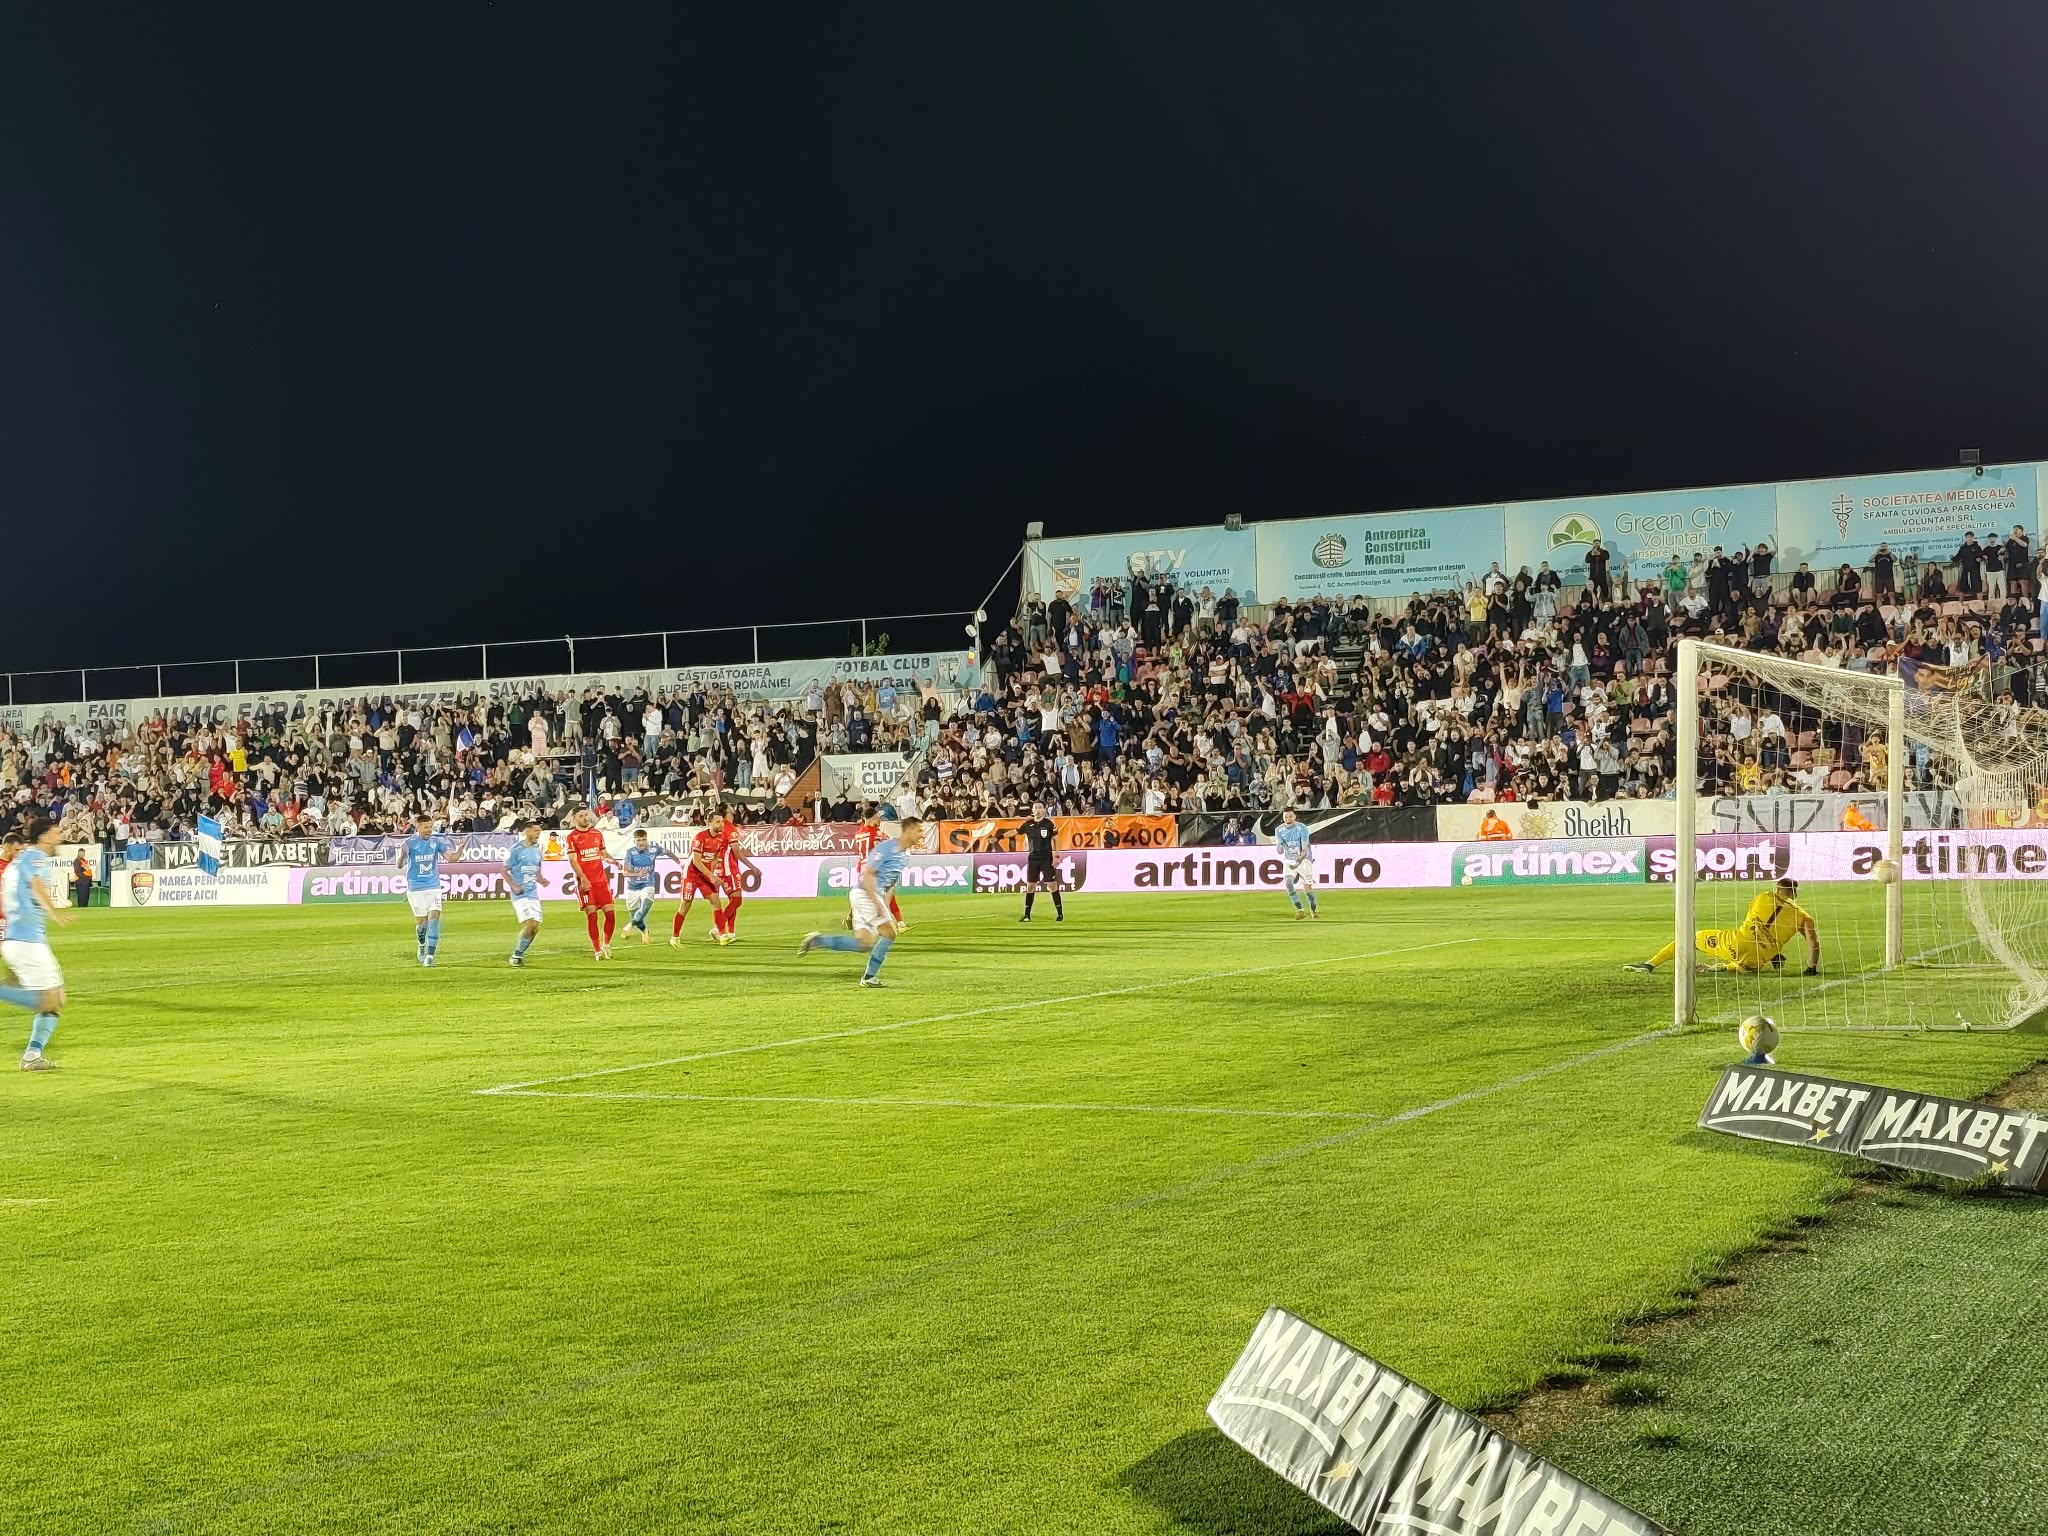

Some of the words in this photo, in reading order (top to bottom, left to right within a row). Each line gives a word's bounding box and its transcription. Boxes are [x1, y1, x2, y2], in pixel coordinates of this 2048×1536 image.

[1863, 492, 1943, 508] SOCIETATEA
[1946, 484, 2016, 502] MEDICALĂ
[1952, 501, 2016, 513] PARASCHEVA
[1615, 512, 1683, 535] Green
[1691, 506, 1734, 532] City
[1902, 515, 1955, 526] VOLUNTARI
[1957, 513, 1975, 522] SRL
[1364, 528, 1426, 541] Antrepriza
[1883, 525, 1934, 536] AMBULATORIU
[1946, 521, 1997, 531] SPECIALITATE
[1639, 532, 1708, 548] Voluntari
[1130, 548, 1187, 574] STV
[1364, 553, 1405, 566] Montaj
[1184, 568, 1230, 578] VOLUNTARI
[835, 658, 888, 673] FOTBAL
[893, 656, 930, 670] CLUB
[489, 681, 519, 699] SAY
[733, 675, 791, 690] ROMÂNIEI
[88, 703, 127, 718] FAIR
[861, 760, 906, 771] FOTBAL
[1564, 806, 1632, 837] Sheikh
[838, 838, 856, 851] TV
[246, 842, 319, 868] MAXBET
[1463, 843, 1640, 878] artimex
[1133, 852, 1381, 887] artime.ro
[159, 875, 193, 887] MAREA
[310, 870, 408, 896] artime
[158, 888, 192, 901] ÎNCEPE
[194, 889, 218, 900] AICI!
[1711, 1071, 1872, 1135] MAXBET
[1865, 1095, 2048, 1169] MAXBET
[1229, 1309, 1428, 1477] MAXBET
[1388, 1413, 1645, 1536] MAXB
